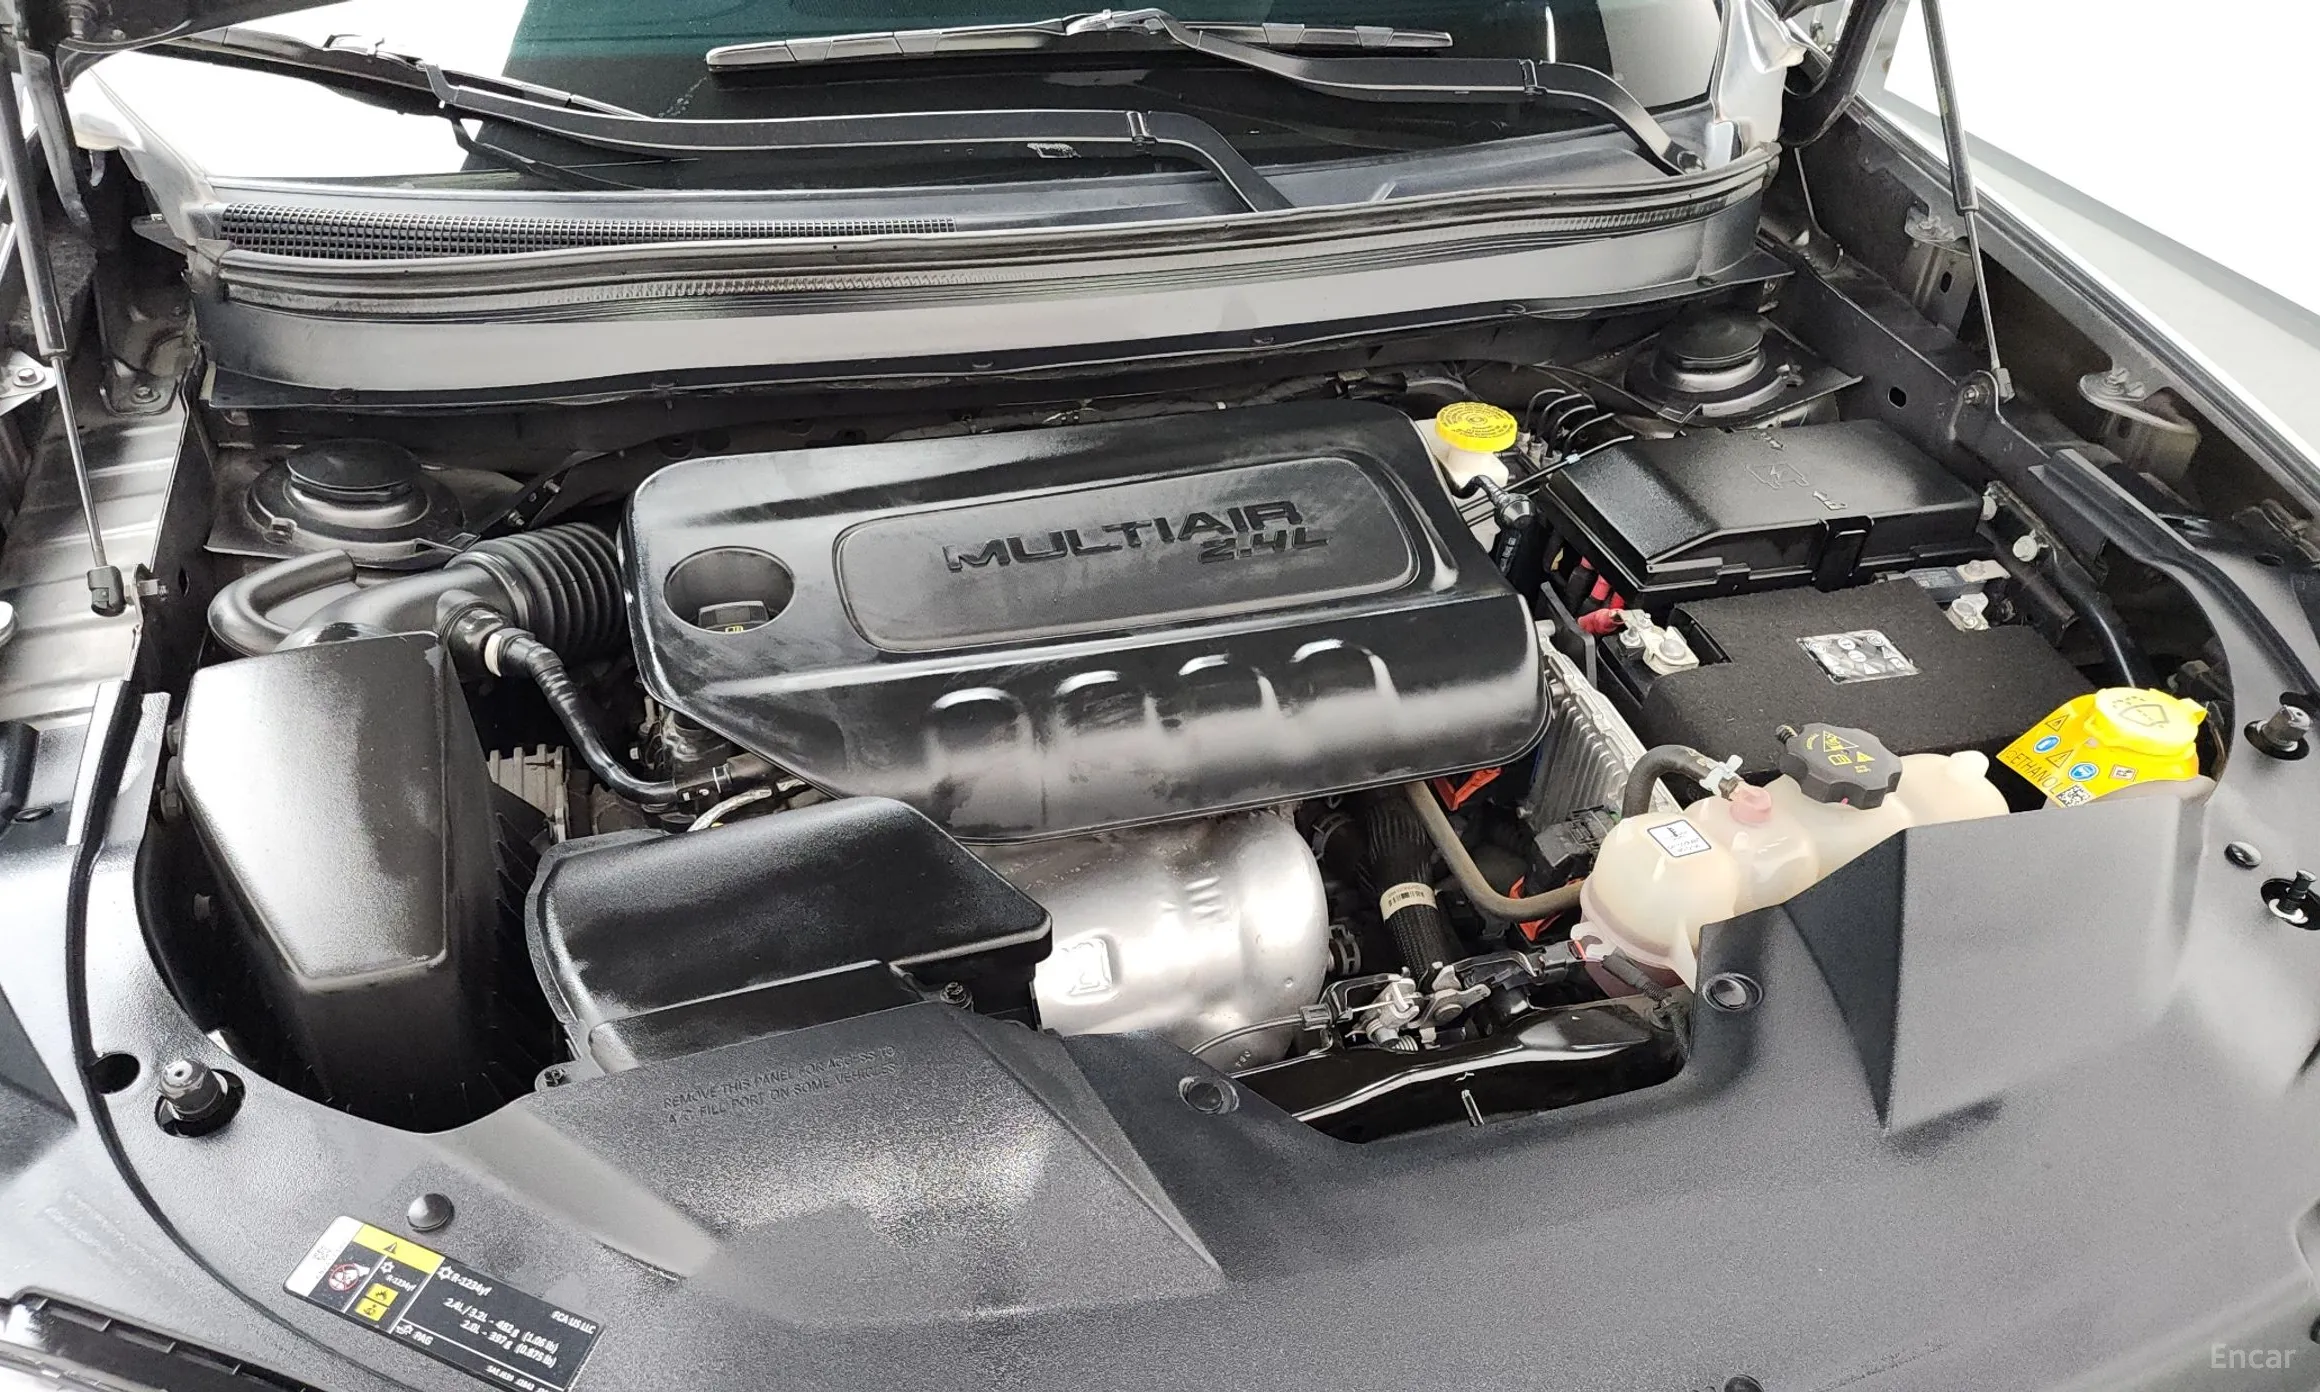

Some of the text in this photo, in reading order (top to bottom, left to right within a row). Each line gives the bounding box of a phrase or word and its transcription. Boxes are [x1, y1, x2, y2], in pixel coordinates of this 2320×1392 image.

[942, 500, 1303, 573] MULTIAIR
[1198, 526, 1331, 565] 2.4L
[2010, 752, 2063, 794] ETHANOL
[664, 1086, 717, 1109] REMOVE
[719, 1077, 751, 1095] THIS
[754, 1065, 794, 1088] PANEL
[699, 1103, 727, 1118] FILL
[730, 1091, 765, 1112] PORT
[769, 1085, 790, 1101] ON
[793, 1077, 831, 1096] SOME
[833, 1060, 898, 1085] VEHICLES
[450, 1272, 493, 1297] R-1234yf
[411, 1330, 434, 1346] PAG
[551, 1310, 597, 1335] FCA US LLC
